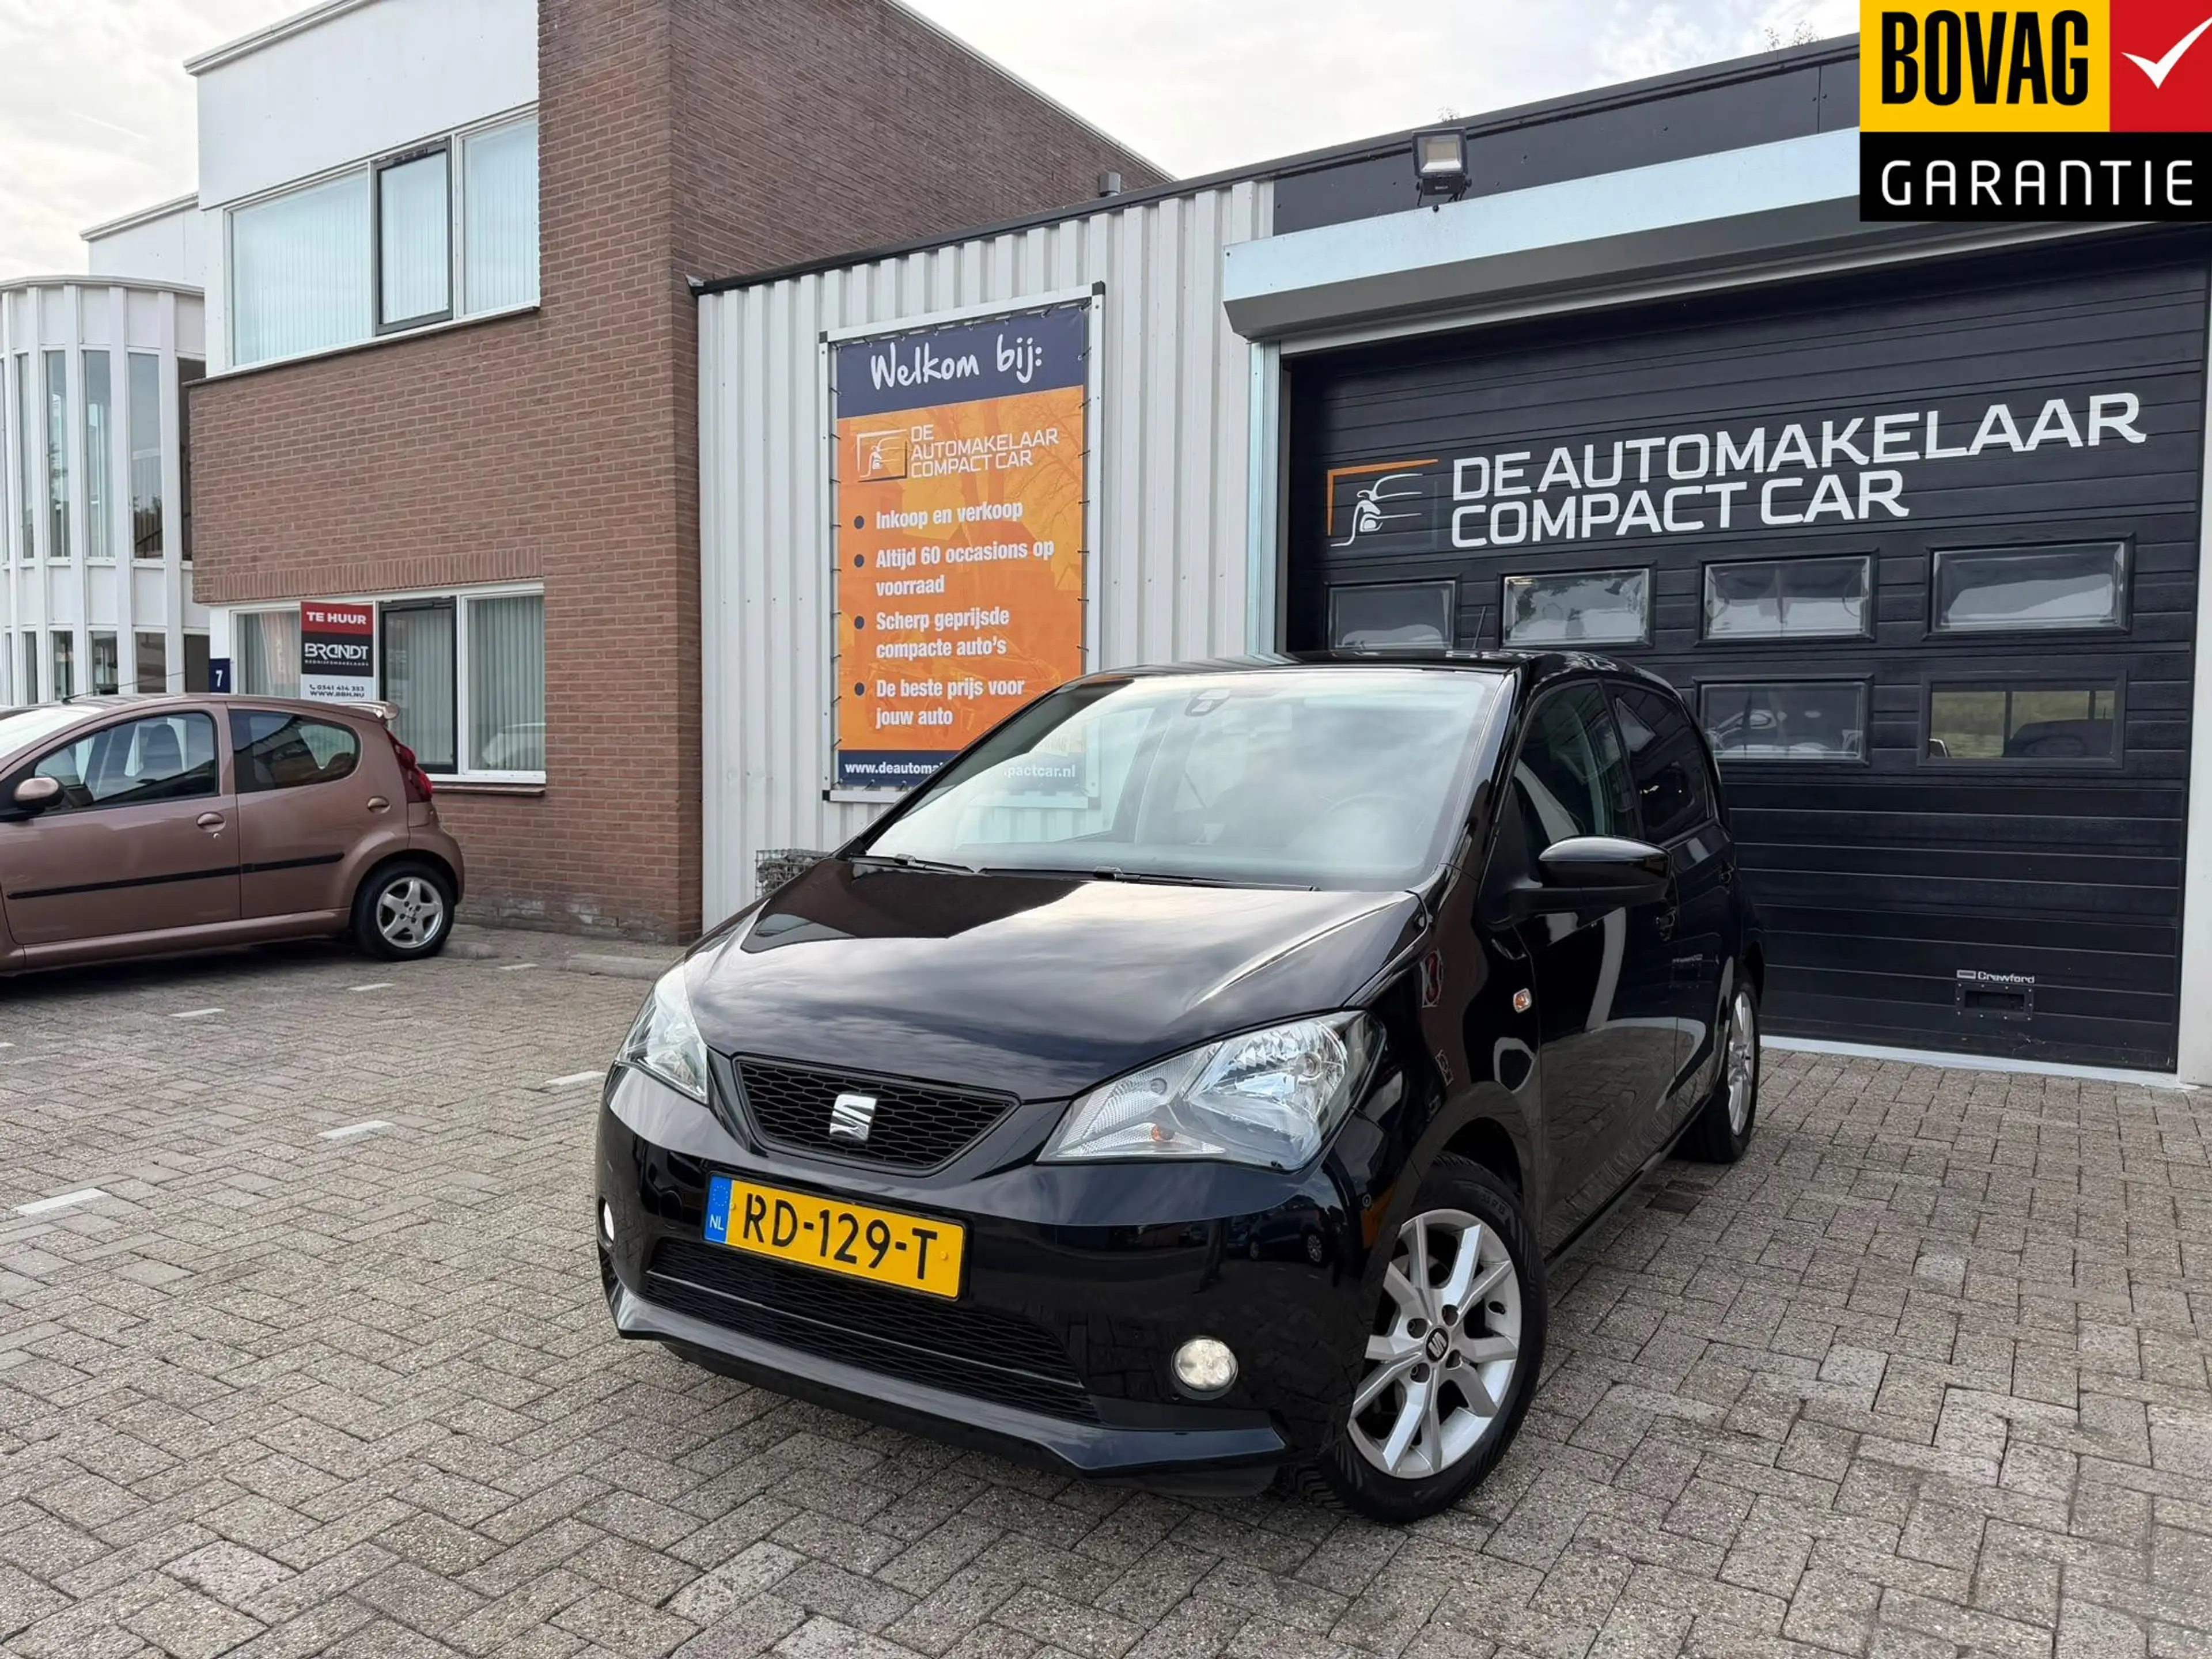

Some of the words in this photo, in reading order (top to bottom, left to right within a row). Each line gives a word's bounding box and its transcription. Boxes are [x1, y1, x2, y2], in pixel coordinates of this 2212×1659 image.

[870, 342, 980, 390] Welkom
[996, 334, 1042, 383] bij:
[910, 428, 1059, 461] AUTOMAKELAAR
[911, 424, 934, 442] DE
[1453, 451, 1531, 501] DE
[1537, 392, 2147, 493] AUTOMAKELAAR
[911, 454, 993, 479] COMPACT
[995, 449, 1033, 469] CAR
[876, 509, 928, 529] Inkoop
[933, 509, 952, 523] en
[956, 501, 1023, 521] verkoop
[1452, 482, 1747, 548] COMPACT
[1760, 469, 1910, 525] CAR
[876, 547, 915, 570] Altijd
[921, 546, 940, 565] 60
[945, 542, 1028, 563] occasions
[1033, 540, 1054, 559] op
[876, 575, 945, 596] voorraad
[306, 611, 324, 622] TE
[327, 612, 367, 625] HUUR
[876, 611, 929, 632] Scherp
[934, 607, 1010, 631] geprijsde
[304, 642, 369, 660] BRANDT
[876, 639, 952, 661] compacte
[956, 635, 1007, 656] auto's
[215, 669, 224, 687] 7
[876, 679, 896, 697] De
[900, 679, 943, 697] beste
[947, 679, 983, 699] prijs
[988, 679, 1024, 695] voor
[875, 708, 914, 729] jouw
[918, 708, 953, 725] auto
[1978, 971, 2035, 983] Crawford
[709, 1215, 724, 1231] NL
[743, 1192, 938, 1280] RD-129-T
